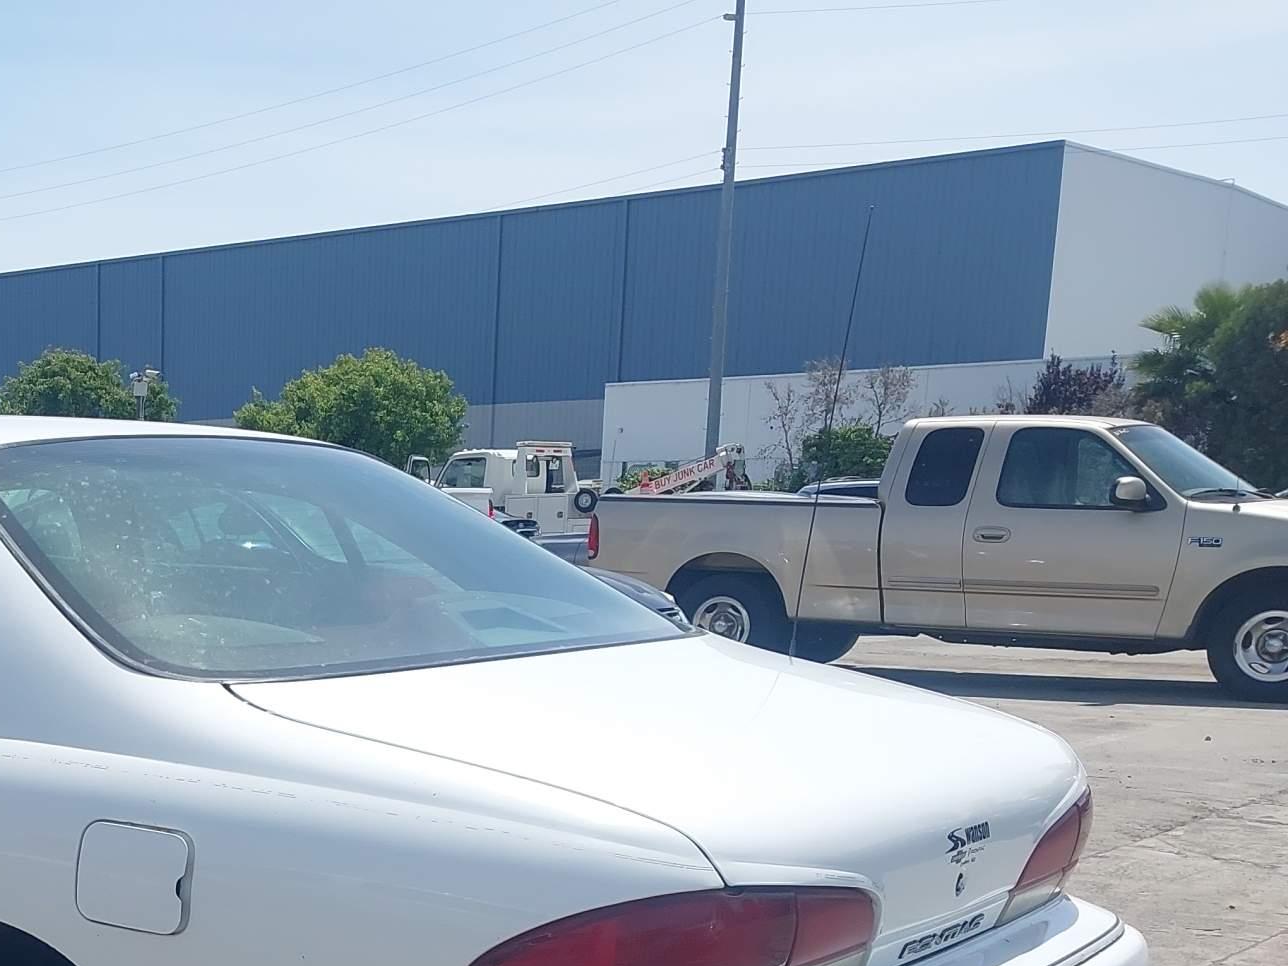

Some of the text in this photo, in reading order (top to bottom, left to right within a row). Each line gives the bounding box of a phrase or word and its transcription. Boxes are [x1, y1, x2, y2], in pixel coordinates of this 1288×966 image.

[654, 459, 715, 490] BUY JUNK CAR
